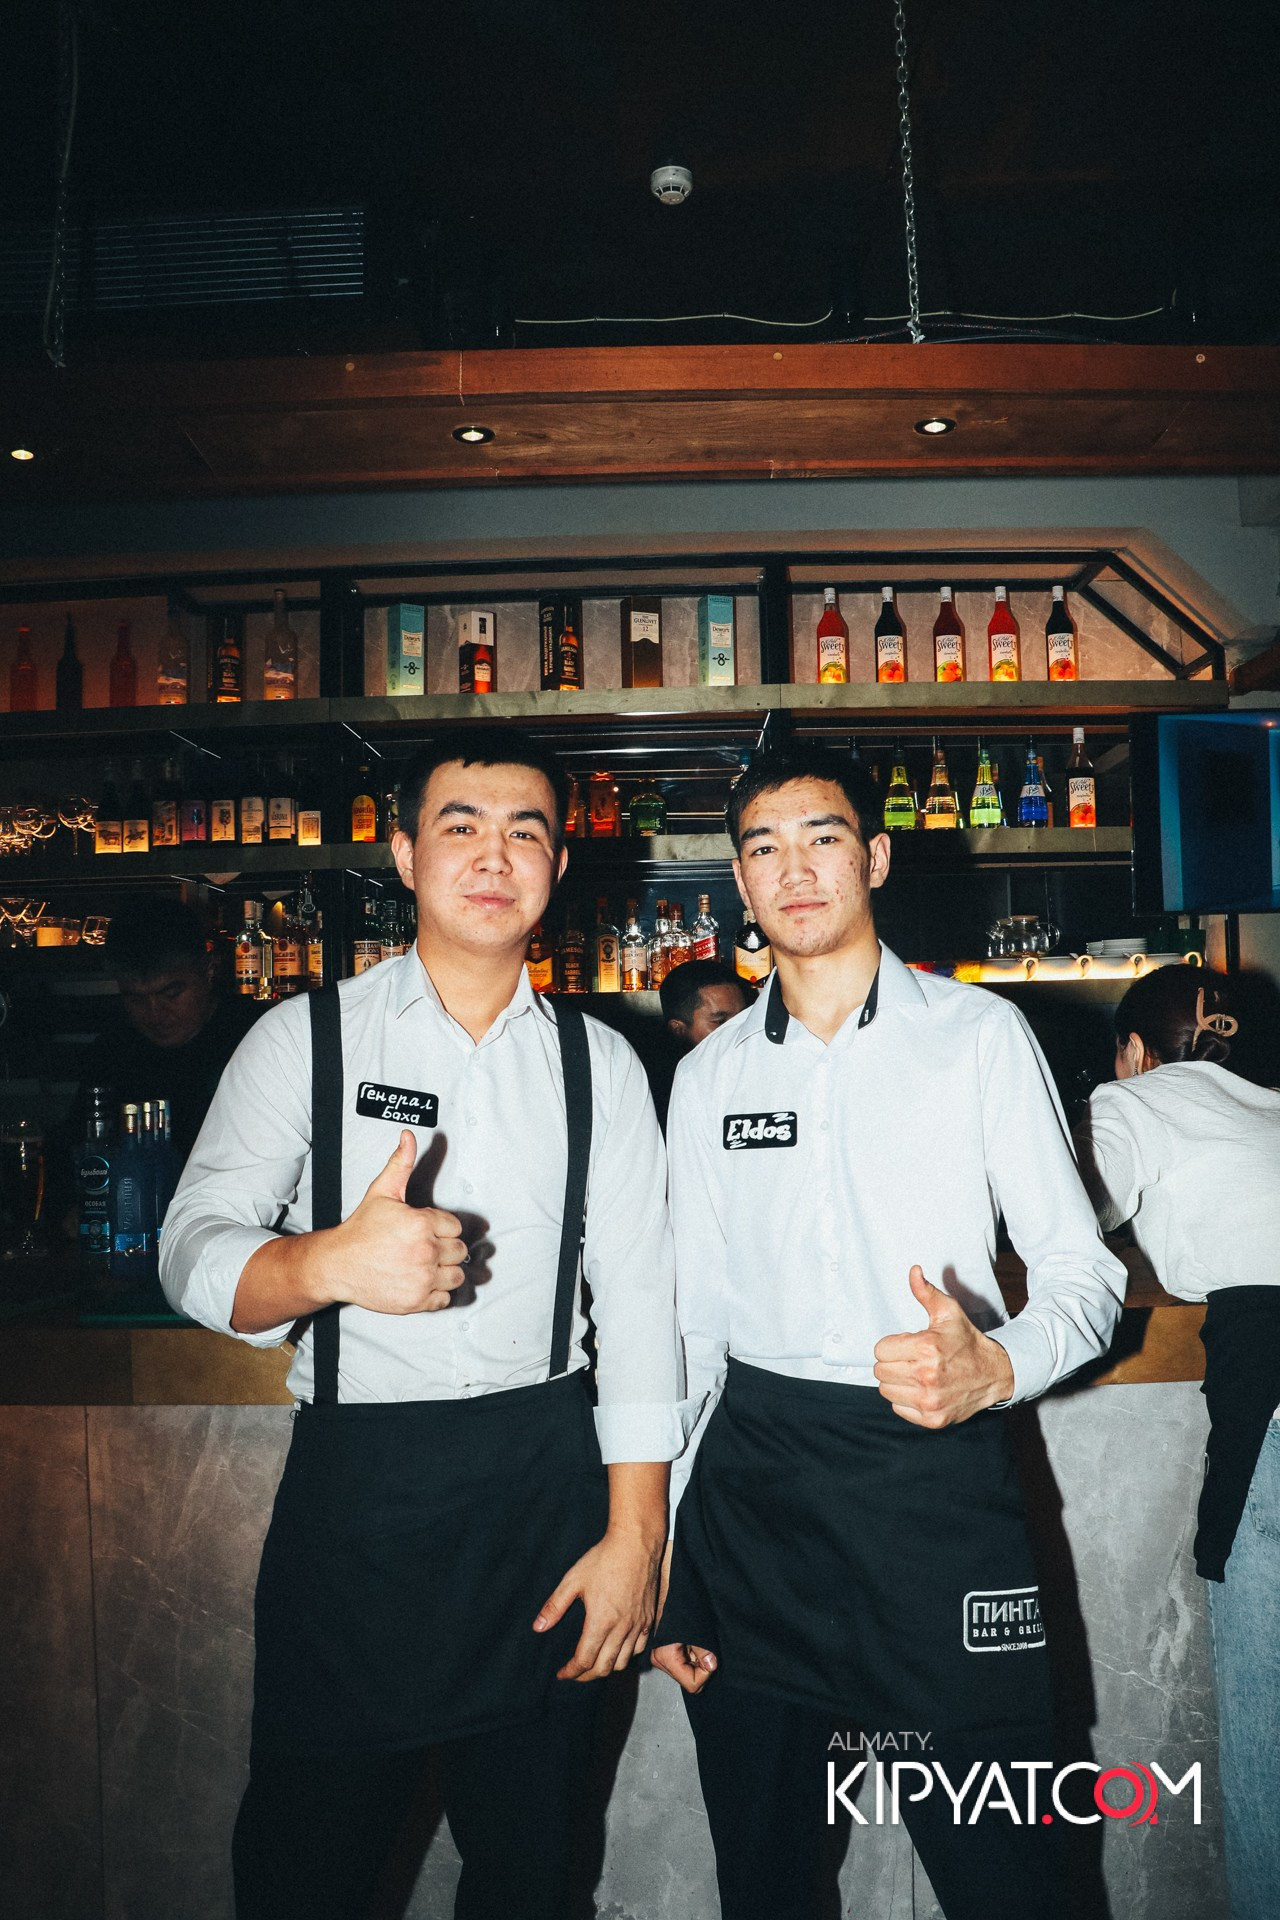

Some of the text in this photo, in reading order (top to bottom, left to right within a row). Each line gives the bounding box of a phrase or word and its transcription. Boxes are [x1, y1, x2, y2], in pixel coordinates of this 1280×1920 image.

[360, 1084, 433, 1110] Генерал
[381, 1105, 420, 1124] Баха
[726, 1118, 792, 1142] Eldos
[972, 1627, 998, 1638] BAR
[1004, 1627, 1010, 1636] &
